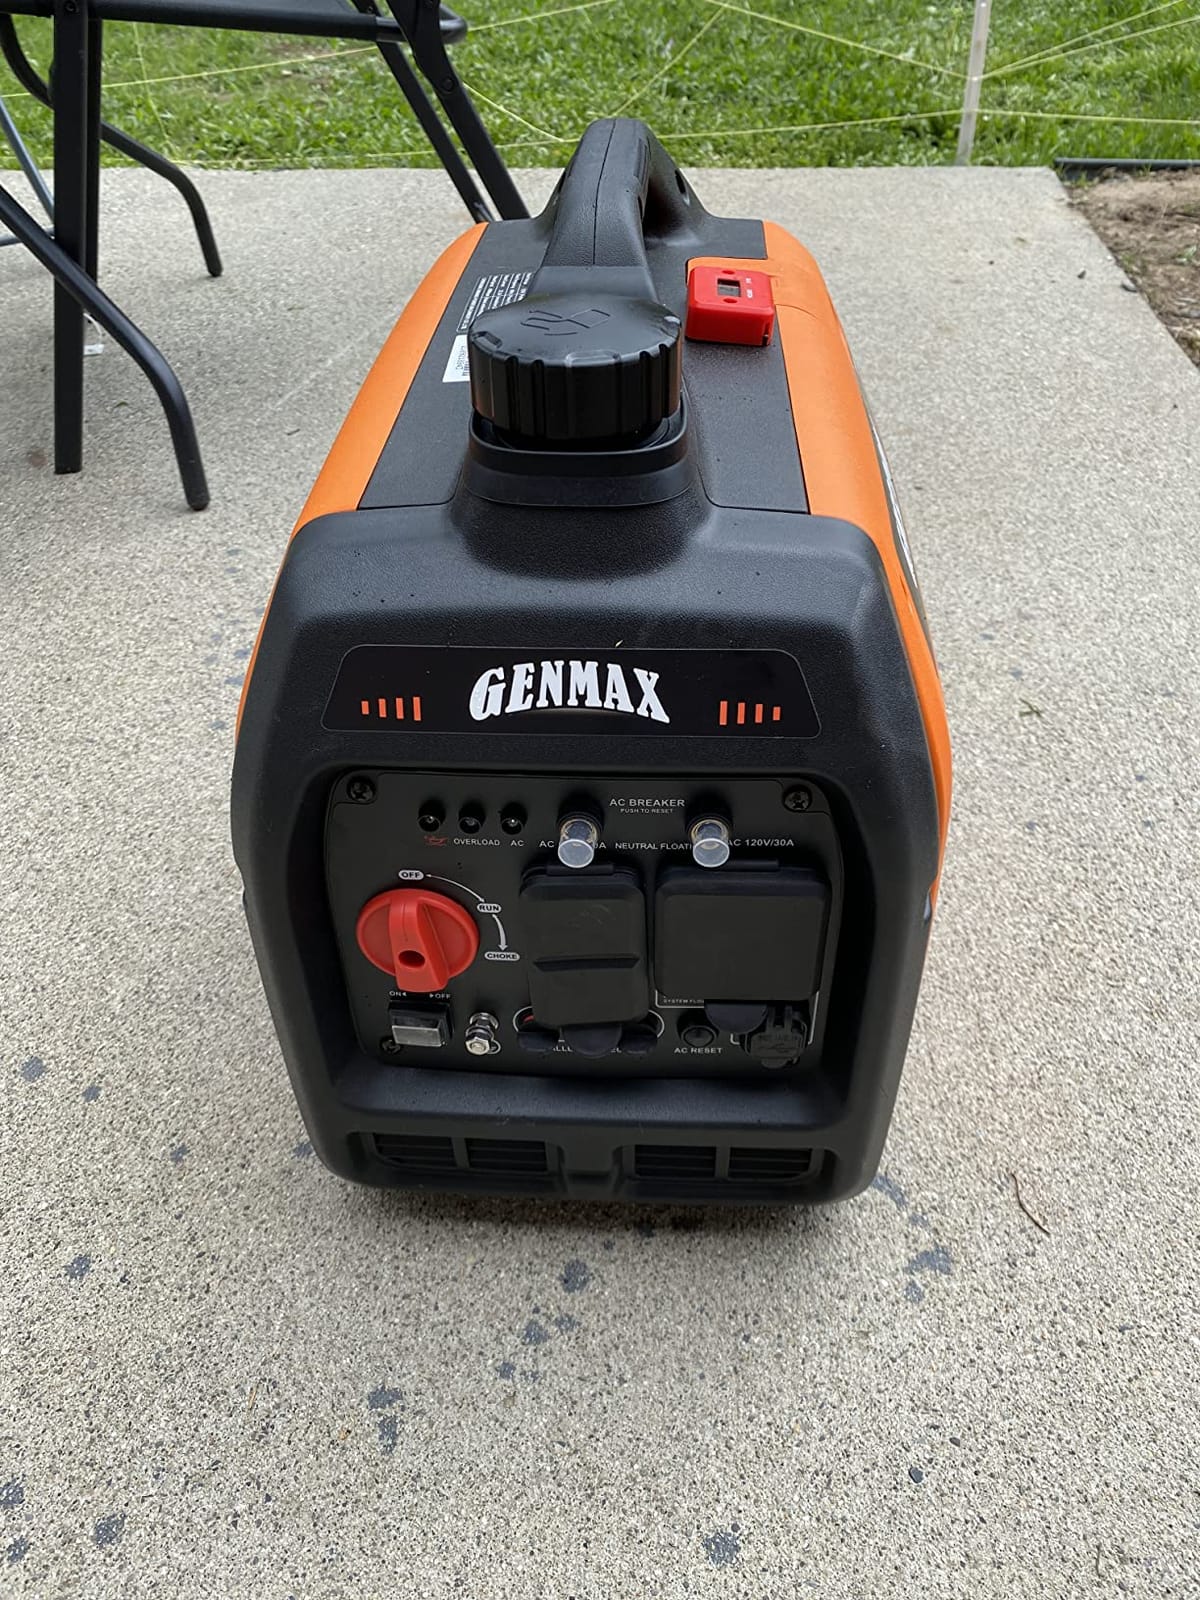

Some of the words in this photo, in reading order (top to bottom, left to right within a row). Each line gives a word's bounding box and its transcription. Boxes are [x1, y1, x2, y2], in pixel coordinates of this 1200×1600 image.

[468, 660, 671, 723] GENMAX
[609, 799, 626, 807] AC
[629, 799, 685, 807] BREAKER
[453, 838, 500, 846] OVERLOAD
[539, 840, 555, 848] AC
[615, 842, 658, 850] NEUTRAL
[745, 839, 795, 847] 120V/30A
[400, 870, 422, 879] OFF
[478, 904, 500, 912] RUN
[486, 952, 518, 960] CHOKE
